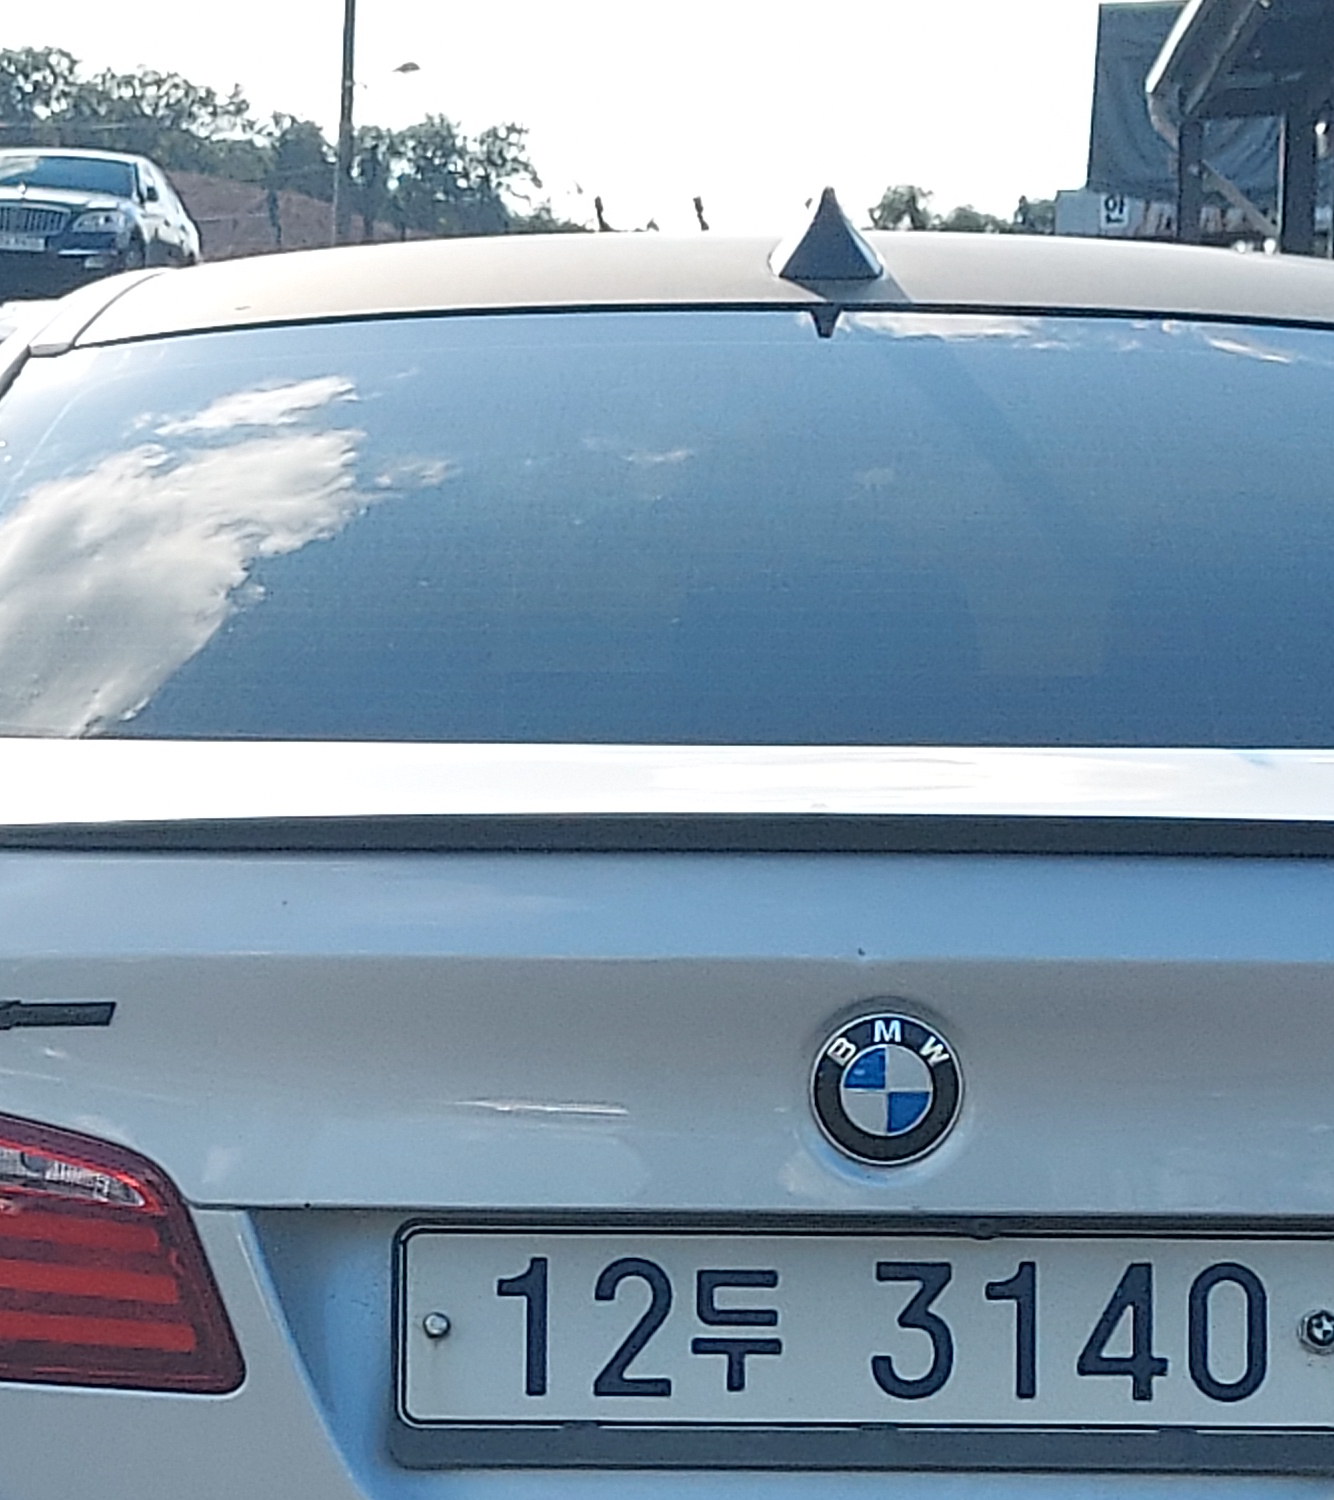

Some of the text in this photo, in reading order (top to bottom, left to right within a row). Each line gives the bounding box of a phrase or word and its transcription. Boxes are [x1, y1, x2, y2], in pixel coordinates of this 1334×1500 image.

[827, 1019, 951, 1067] BMW
[495, 1256, 1268, 1403] 12두 3140
